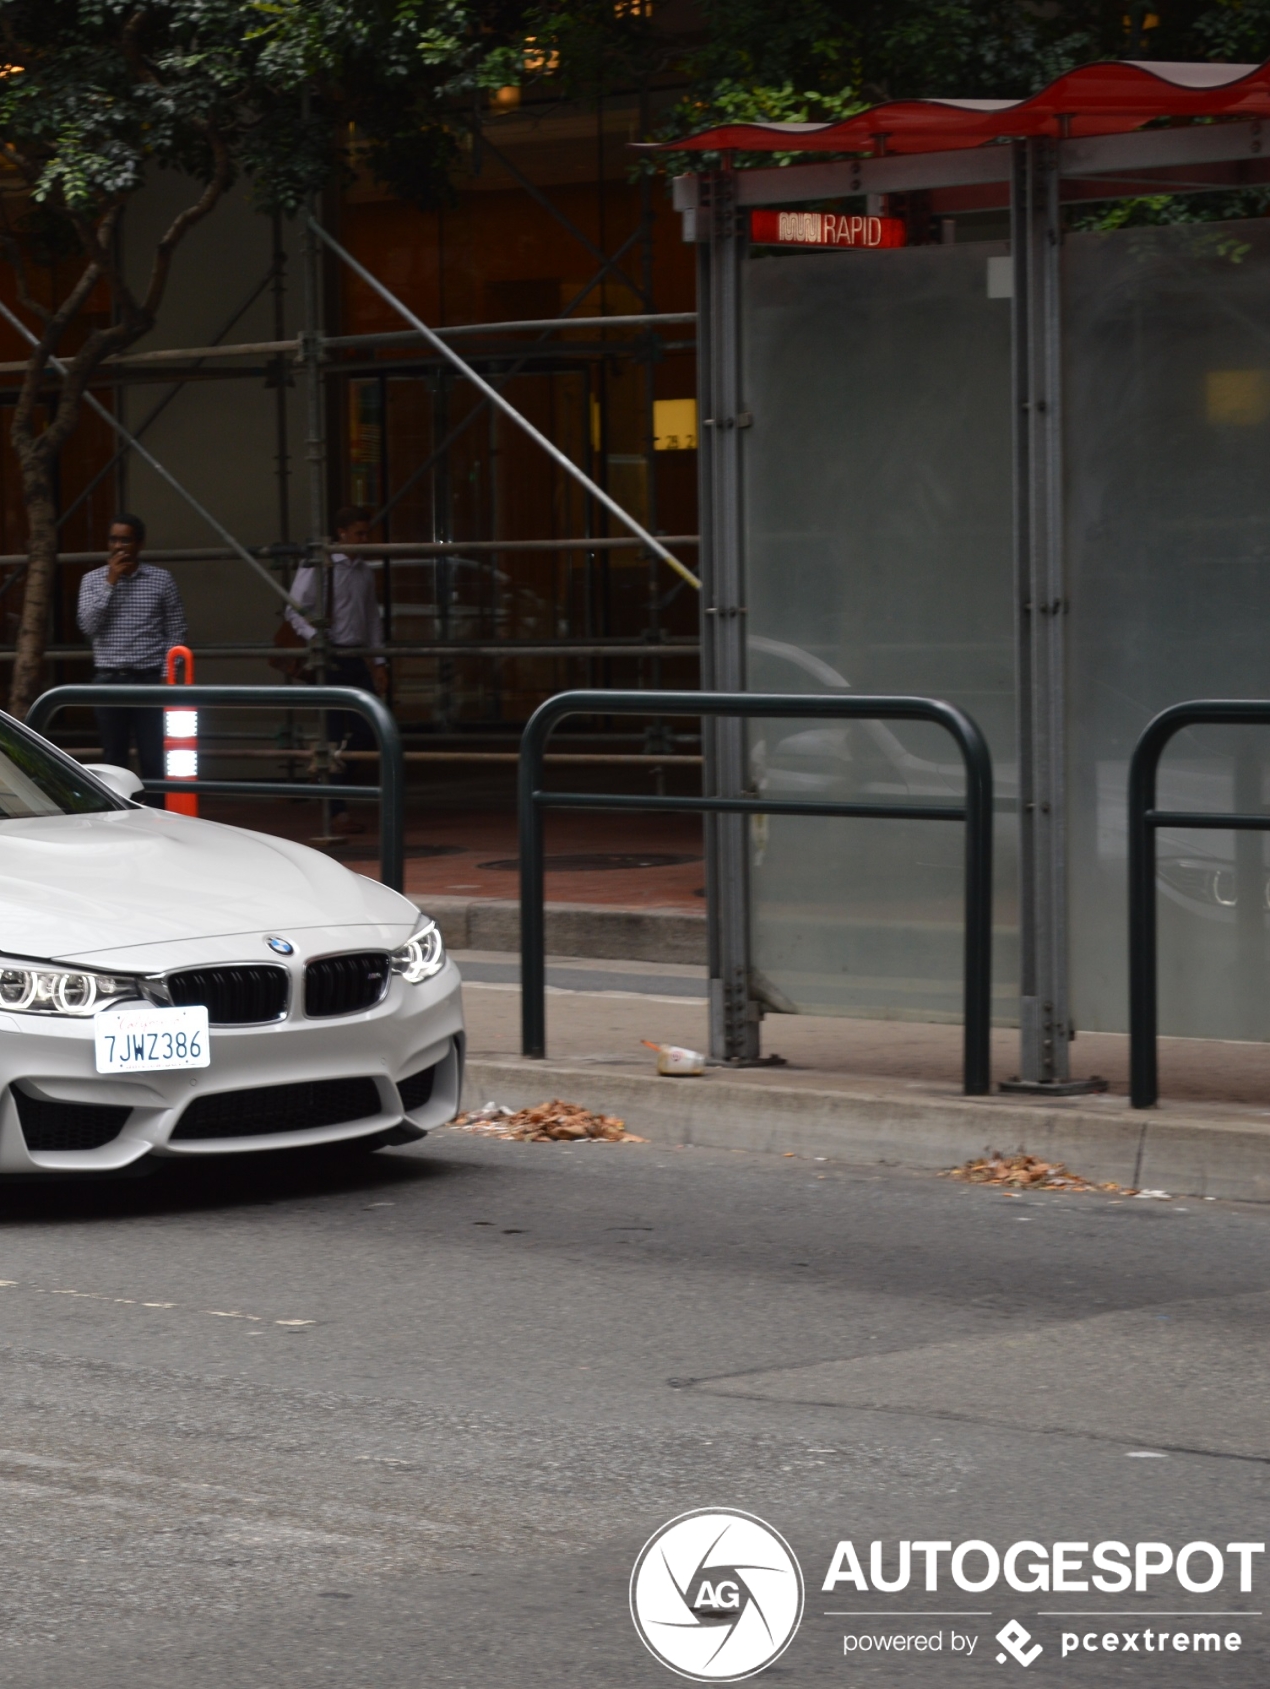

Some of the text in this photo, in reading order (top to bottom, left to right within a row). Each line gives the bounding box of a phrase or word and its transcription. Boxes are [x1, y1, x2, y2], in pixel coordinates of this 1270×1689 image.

[823, 214, 882, 246] RAPID
[119, 1014, 180, 1033] Caifa
[104, 1030, 202, 1063] 7JWZ386
